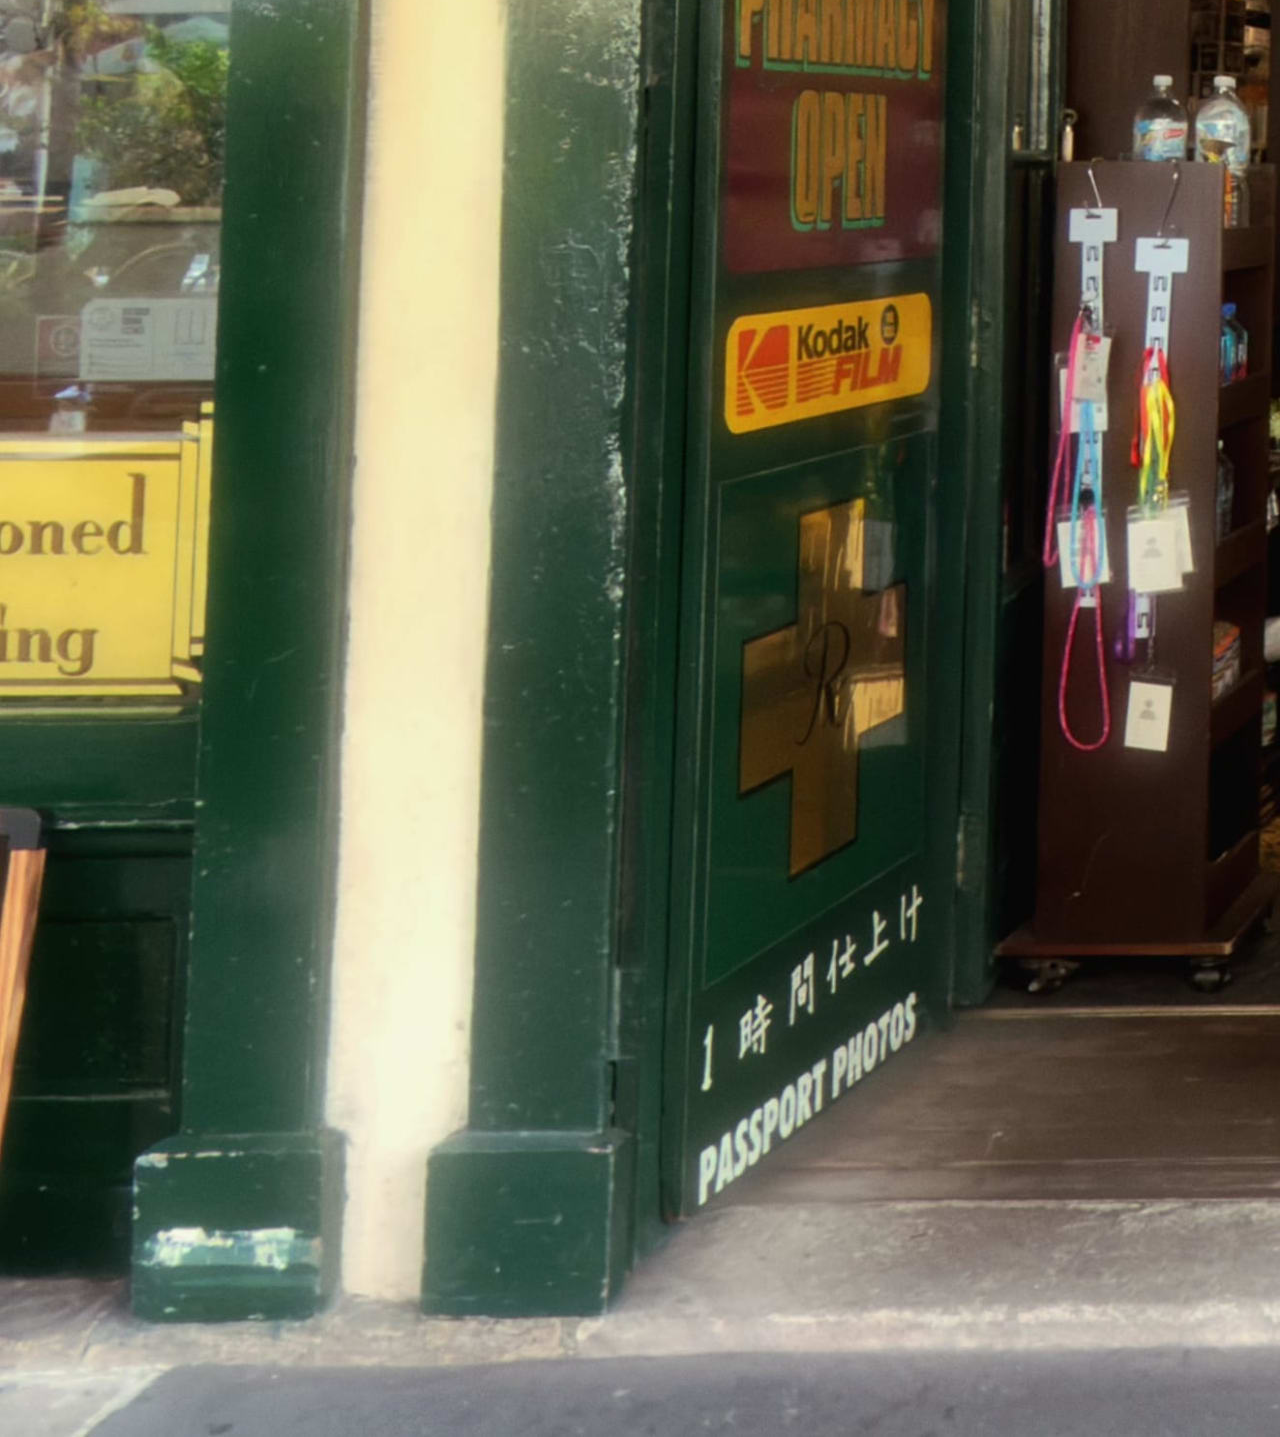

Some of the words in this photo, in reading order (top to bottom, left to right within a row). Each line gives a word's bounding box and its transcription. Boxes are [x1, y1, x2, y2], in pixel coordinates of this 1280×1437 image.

[790, 88, 888, 232] OPEN
[797, 316, 871, 361] Kodak
[832, 344, 904, 396] FILM
[698, 1059, 827, 1206] PASSPORT
[831, 991, 917, 1099] PHOTOS
